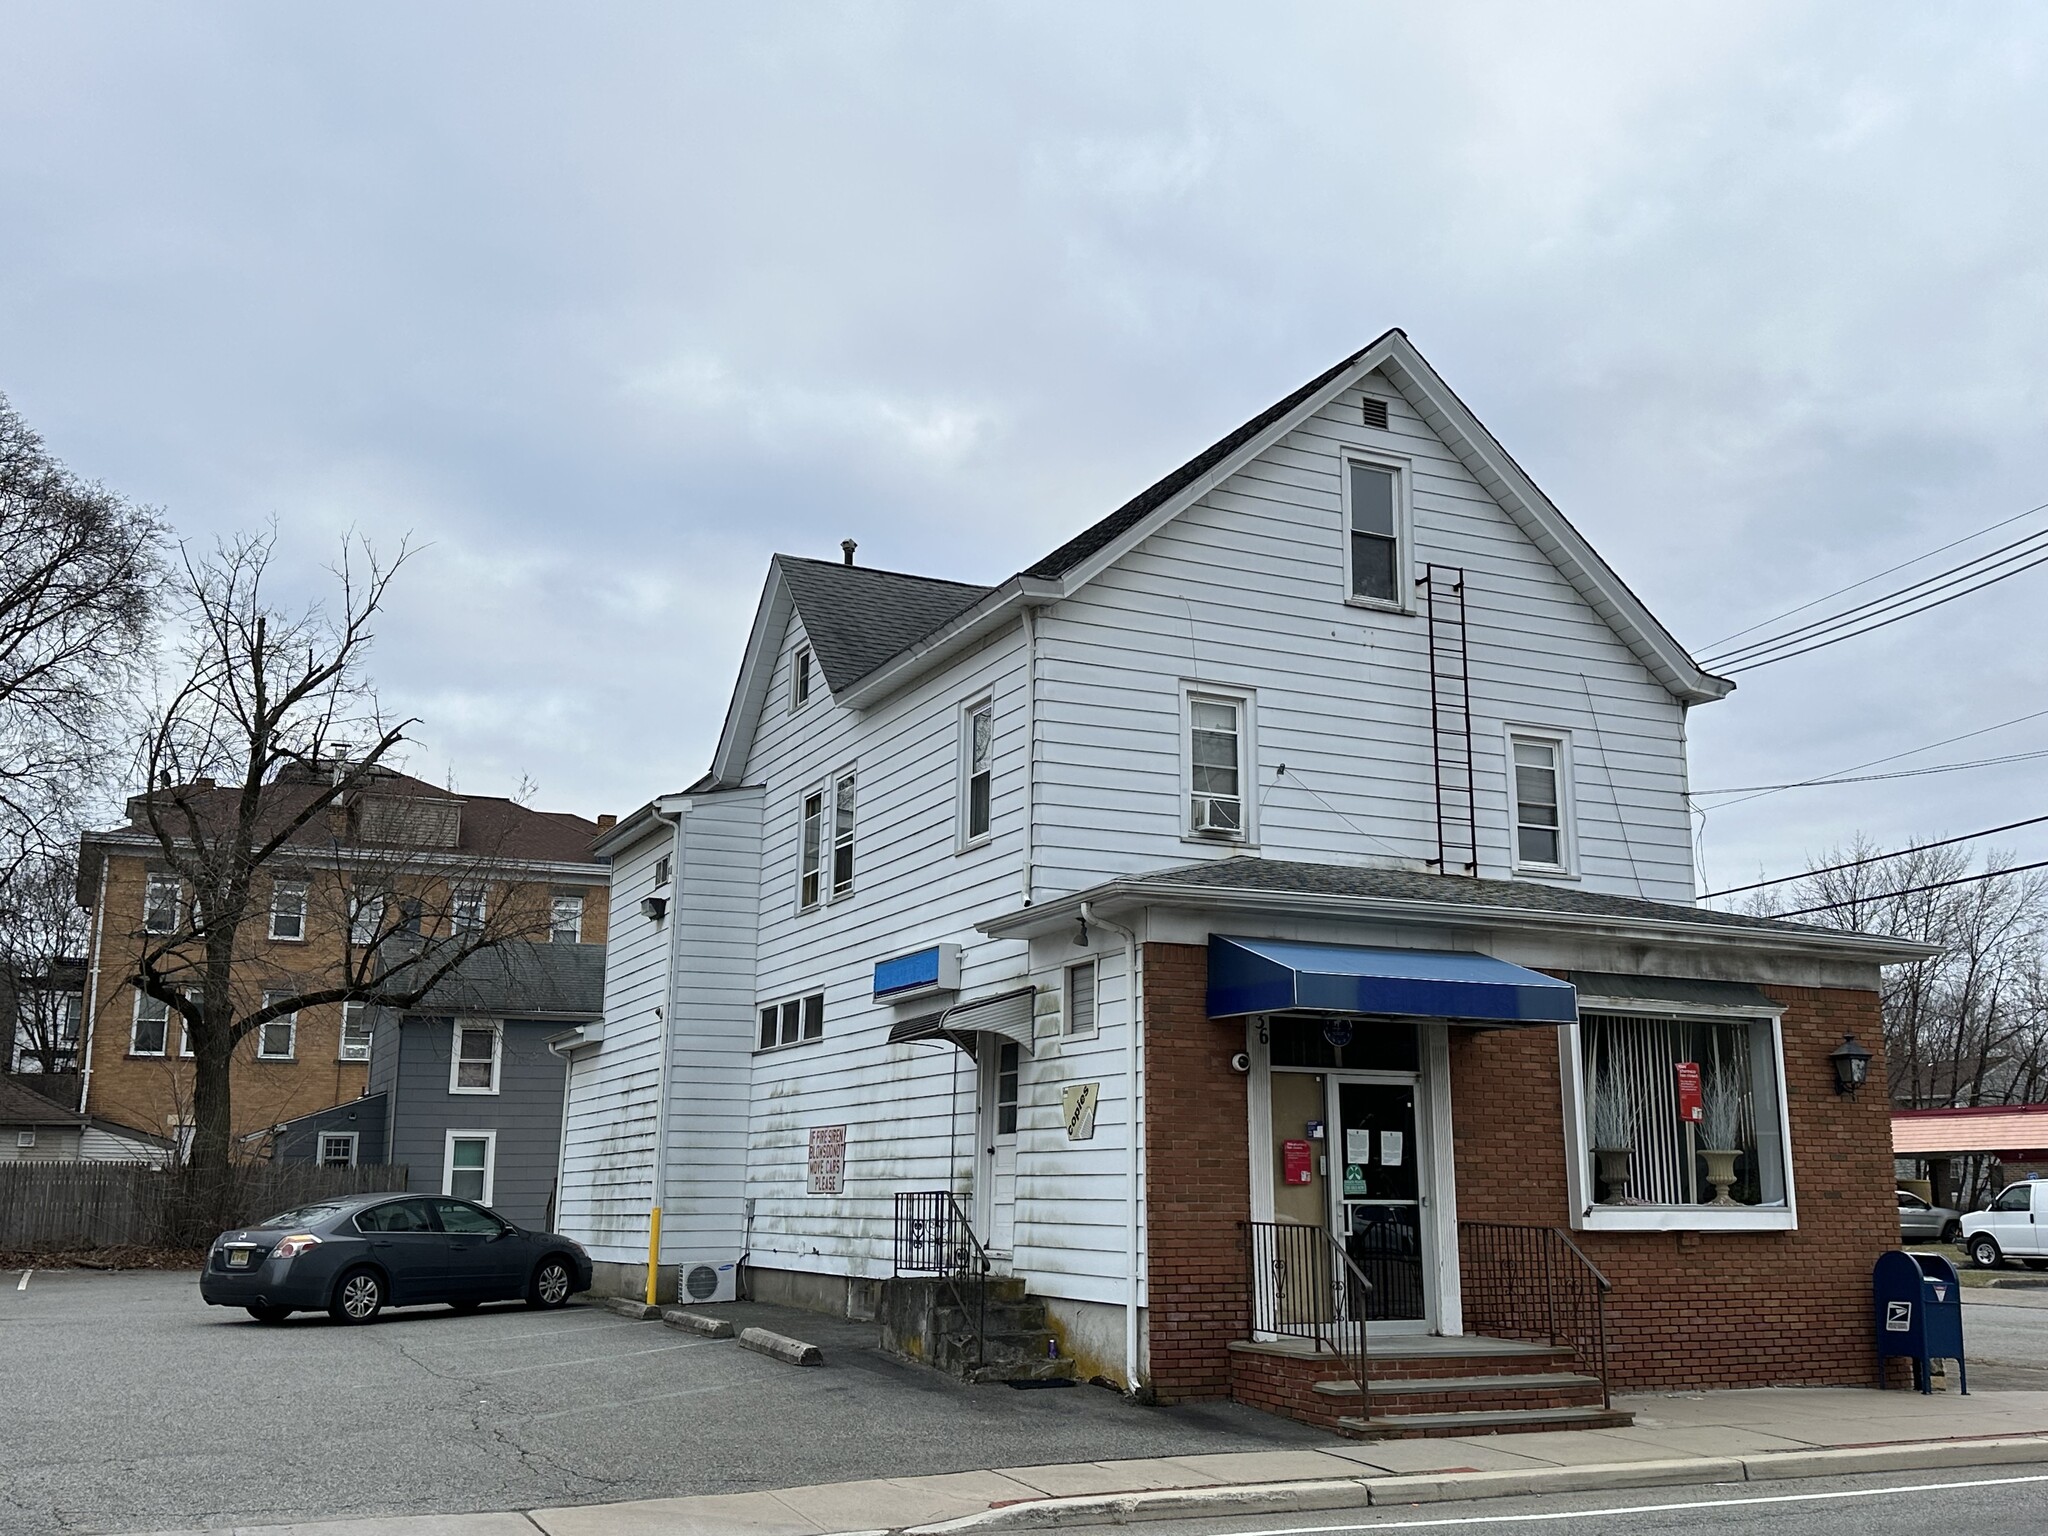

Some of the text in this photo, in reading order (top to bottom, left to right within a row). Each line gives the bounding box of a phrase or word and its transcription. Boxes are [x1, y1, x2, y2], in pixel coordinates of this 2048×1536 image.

[810, 1130, 816, 1144] IF
[809, 1145, 826, 1159] BLOWS
[810, 1159, 840, 1175] MOVE CARS
[815, 1176, 836, 1191] PLEASE
